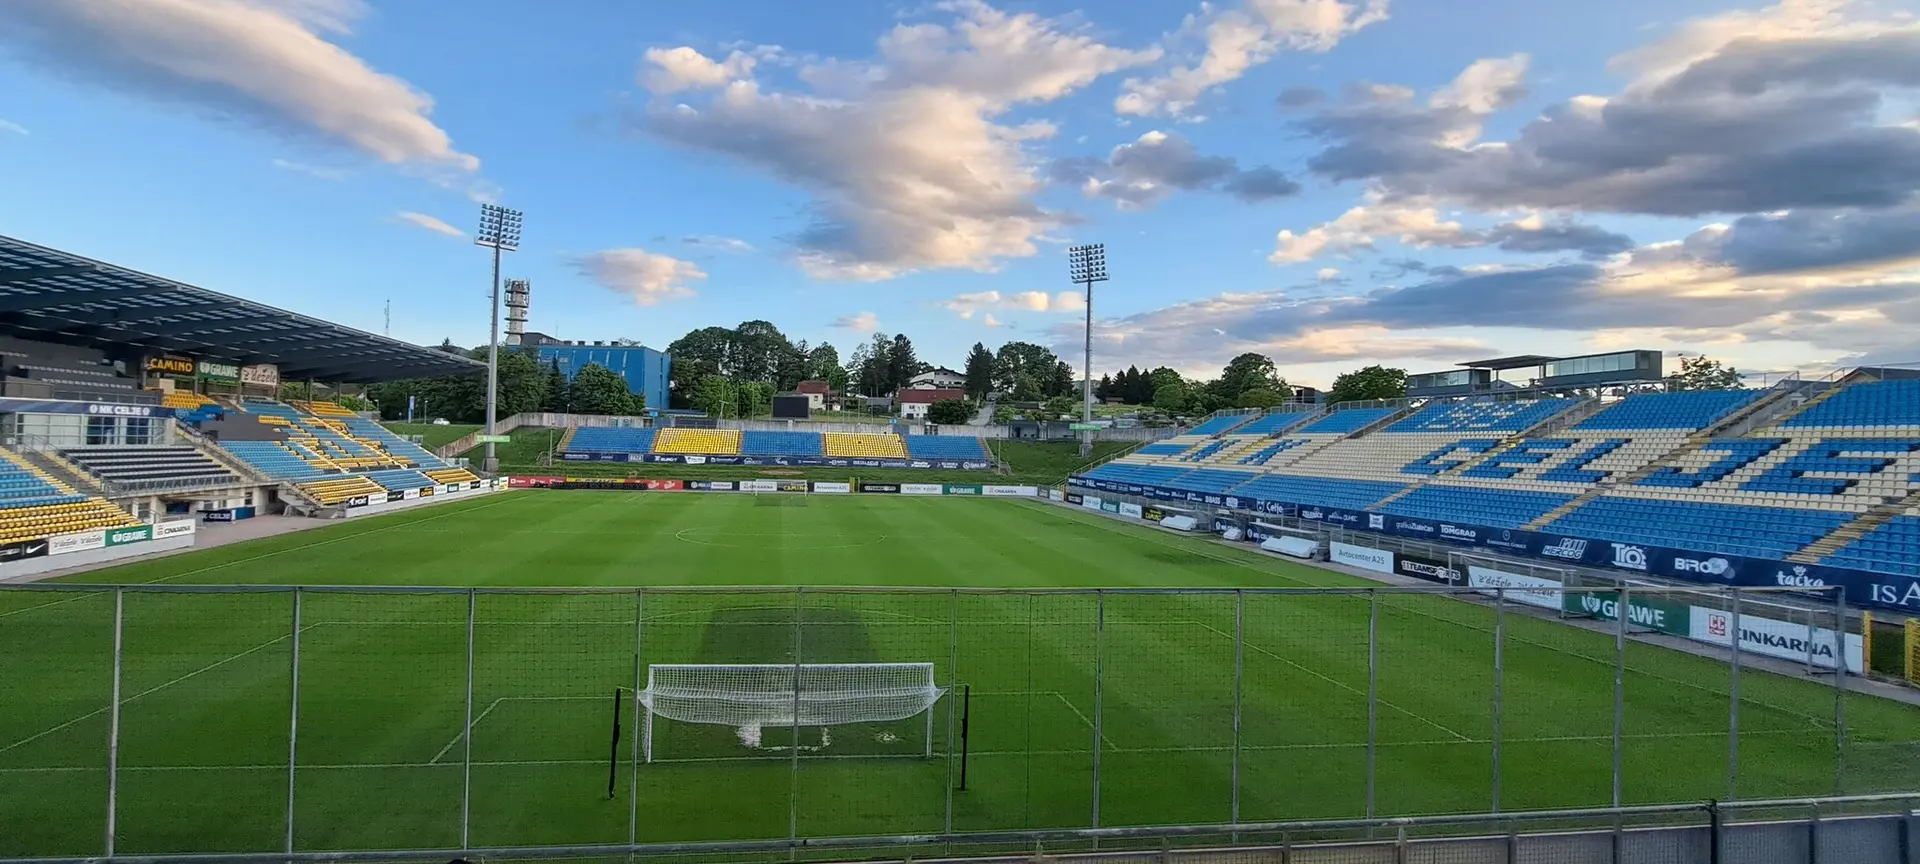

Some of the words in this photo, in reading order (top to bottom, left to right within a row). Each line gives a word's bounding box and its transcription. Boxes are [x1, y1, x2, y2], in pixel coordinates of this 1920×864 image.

[151, 358, 193, 373] CAMINO
[211, 363, 239, 378] GRAWE
[100, 406, 113, 414] NK
[115, 406, 142, 416] CELJE
[1338, 549, 1372, 563] Avtocenter
